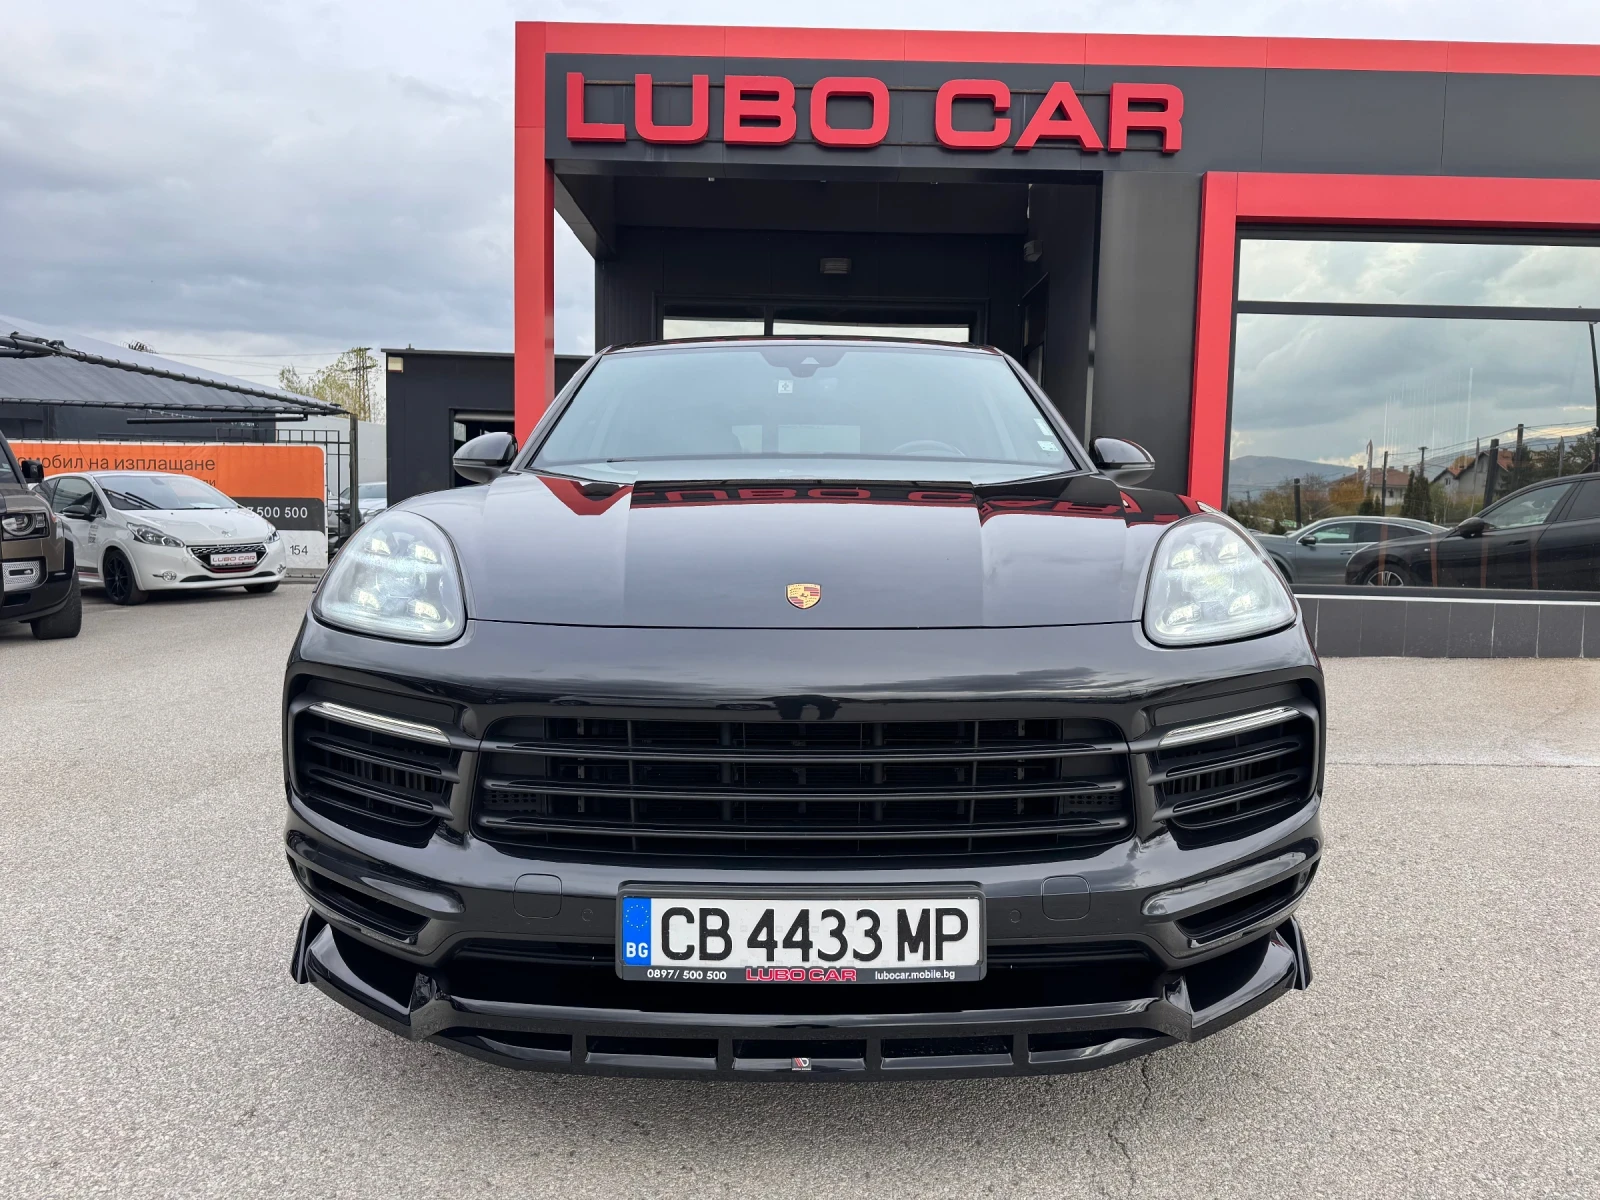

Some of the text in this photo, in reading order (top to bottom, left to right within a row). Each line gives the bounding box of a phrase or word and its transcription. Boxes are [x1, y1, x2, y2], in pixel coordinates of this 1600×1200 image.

[566, 72, 1186, 154] LUBO CAR
[89, 458, 109, 469] на
[114, 459, 216, 472] изплащане
[256, 506, 280, 518] 500
[284, 507, 308, 518] 500
[289, 545, 309, 555] 154
[661, 907, 969, 962] CB 4433 MP
[626, 942, 649, 958] BG
[647, 968, 956, 982] 0897/ 500 500 LUBO CAR lubocar.mobile.bg
